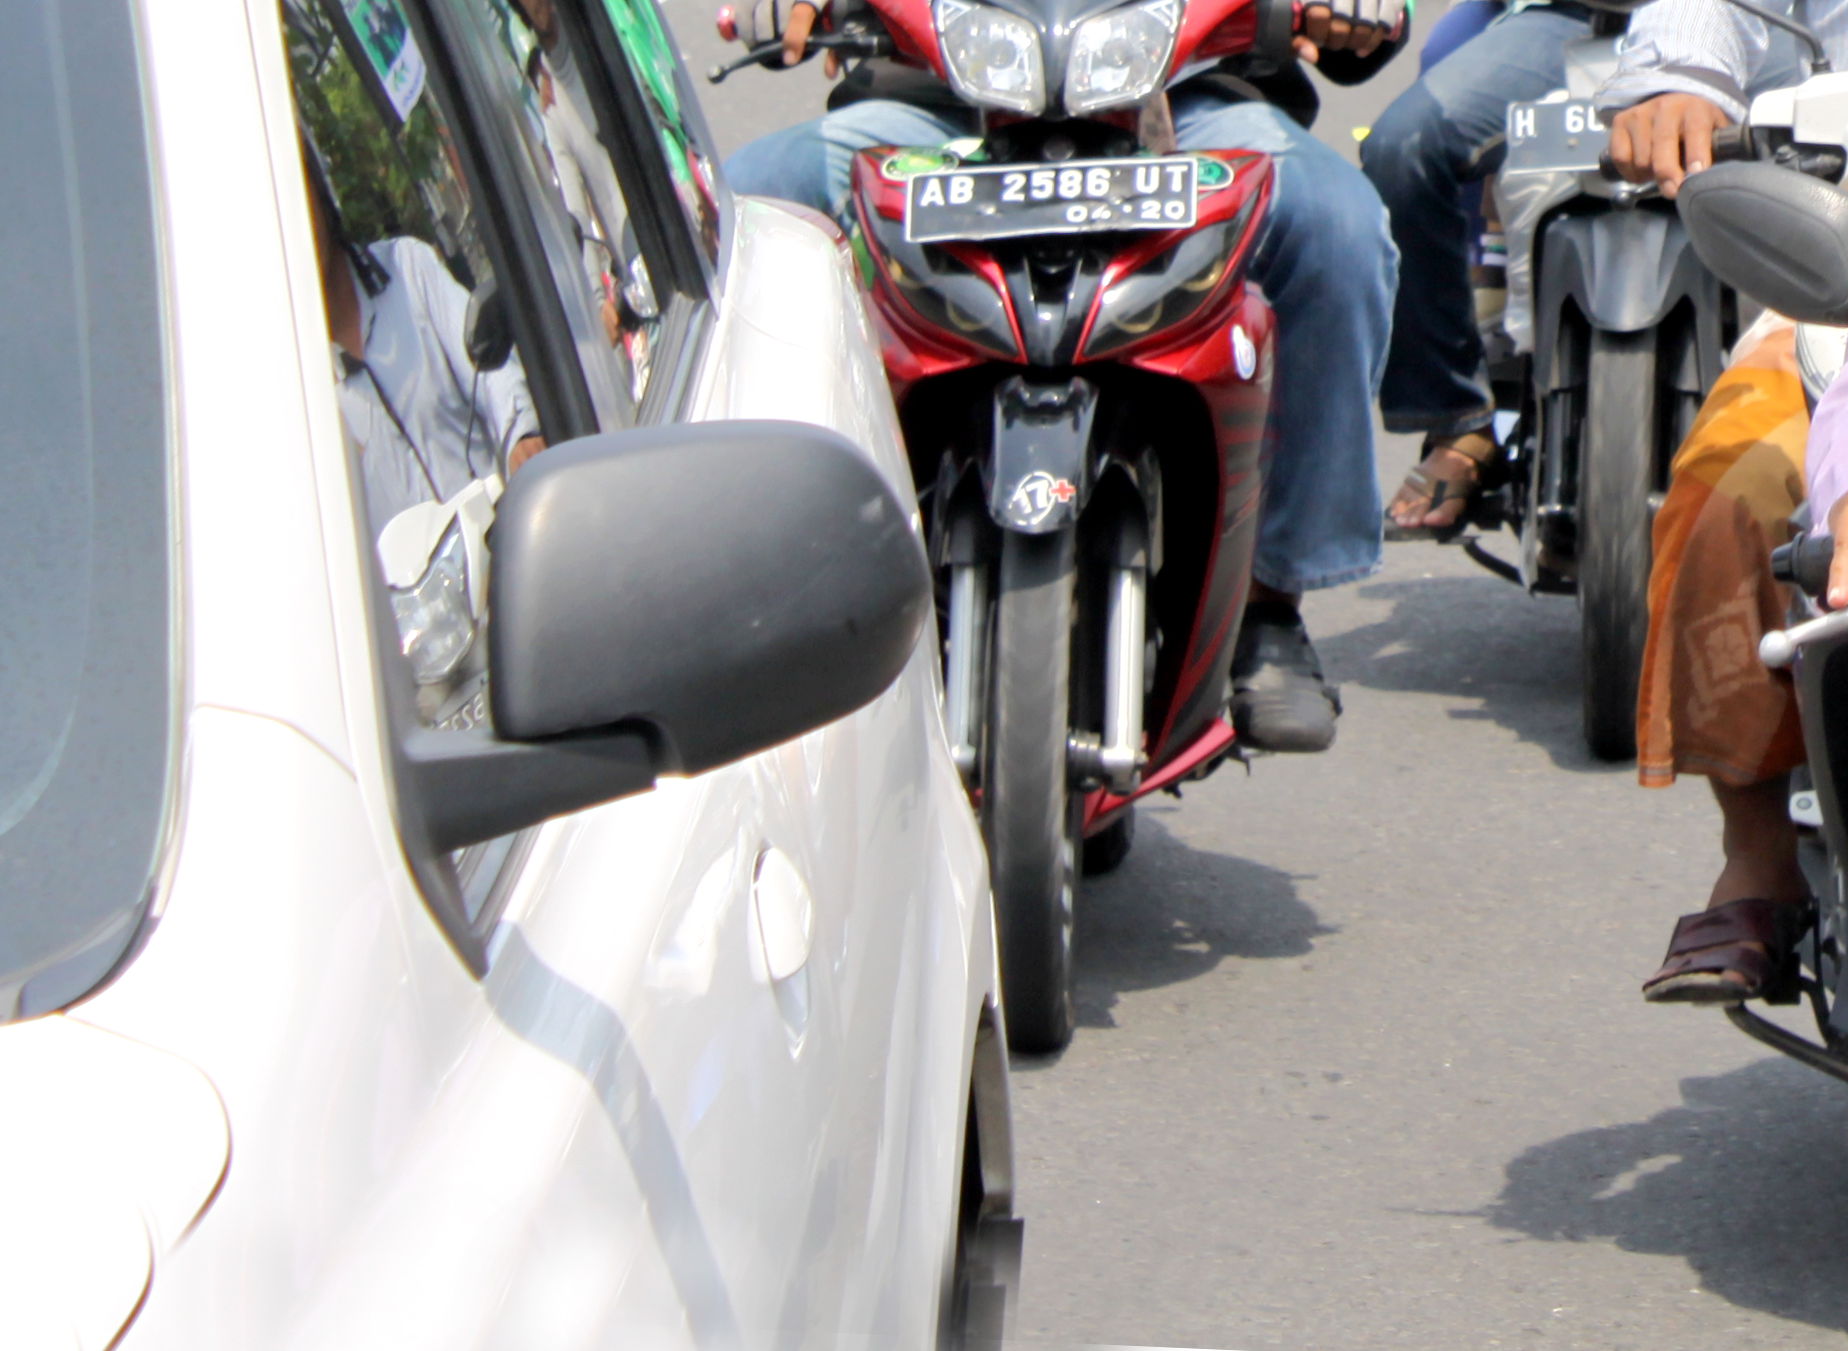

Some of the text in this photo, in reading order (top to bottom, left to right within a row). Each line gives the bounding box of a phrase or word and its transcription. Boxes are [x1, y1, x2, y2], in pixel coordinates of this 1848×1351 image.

[1515, 108, 1536, 138] H
[919, 165, 1189, 207] AB 2586 UT
